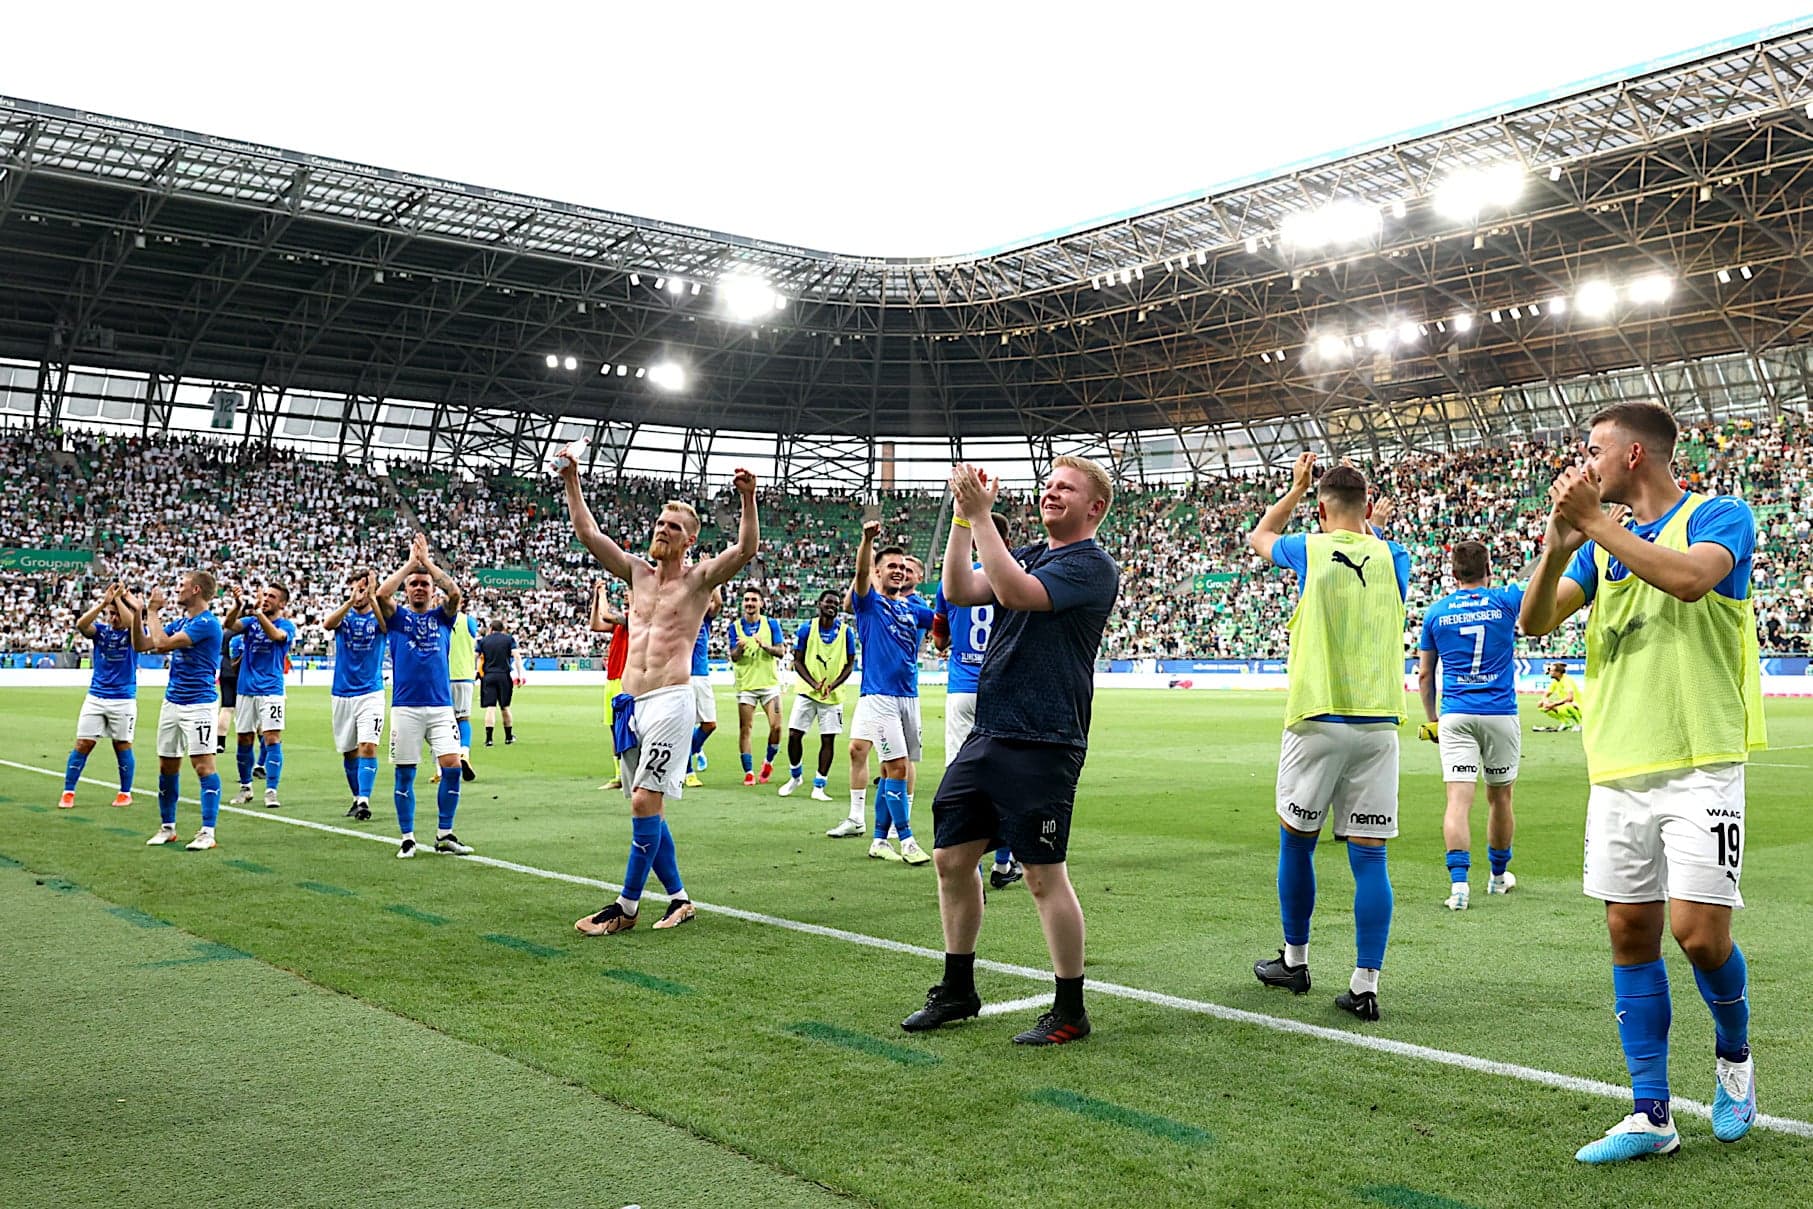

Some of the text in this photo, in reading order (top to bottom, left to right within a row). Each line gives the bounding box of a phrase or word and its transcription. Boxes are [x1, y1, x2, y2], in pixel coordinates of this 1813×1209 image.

[220, 398, 234, 413] 12
[483, 575, 535, 586] Groupama
[1439, 609, 1503, 626] FREDERIKSBERG
[970, 604, 994, 651] 8
[1460, 625, 1485, 675] 7
[579, 658, 592, 669] B3
[196, 725, 211, 741] 17
[645, 748, 671, 773] 22
[1710, 822, 1740, 868] 19
